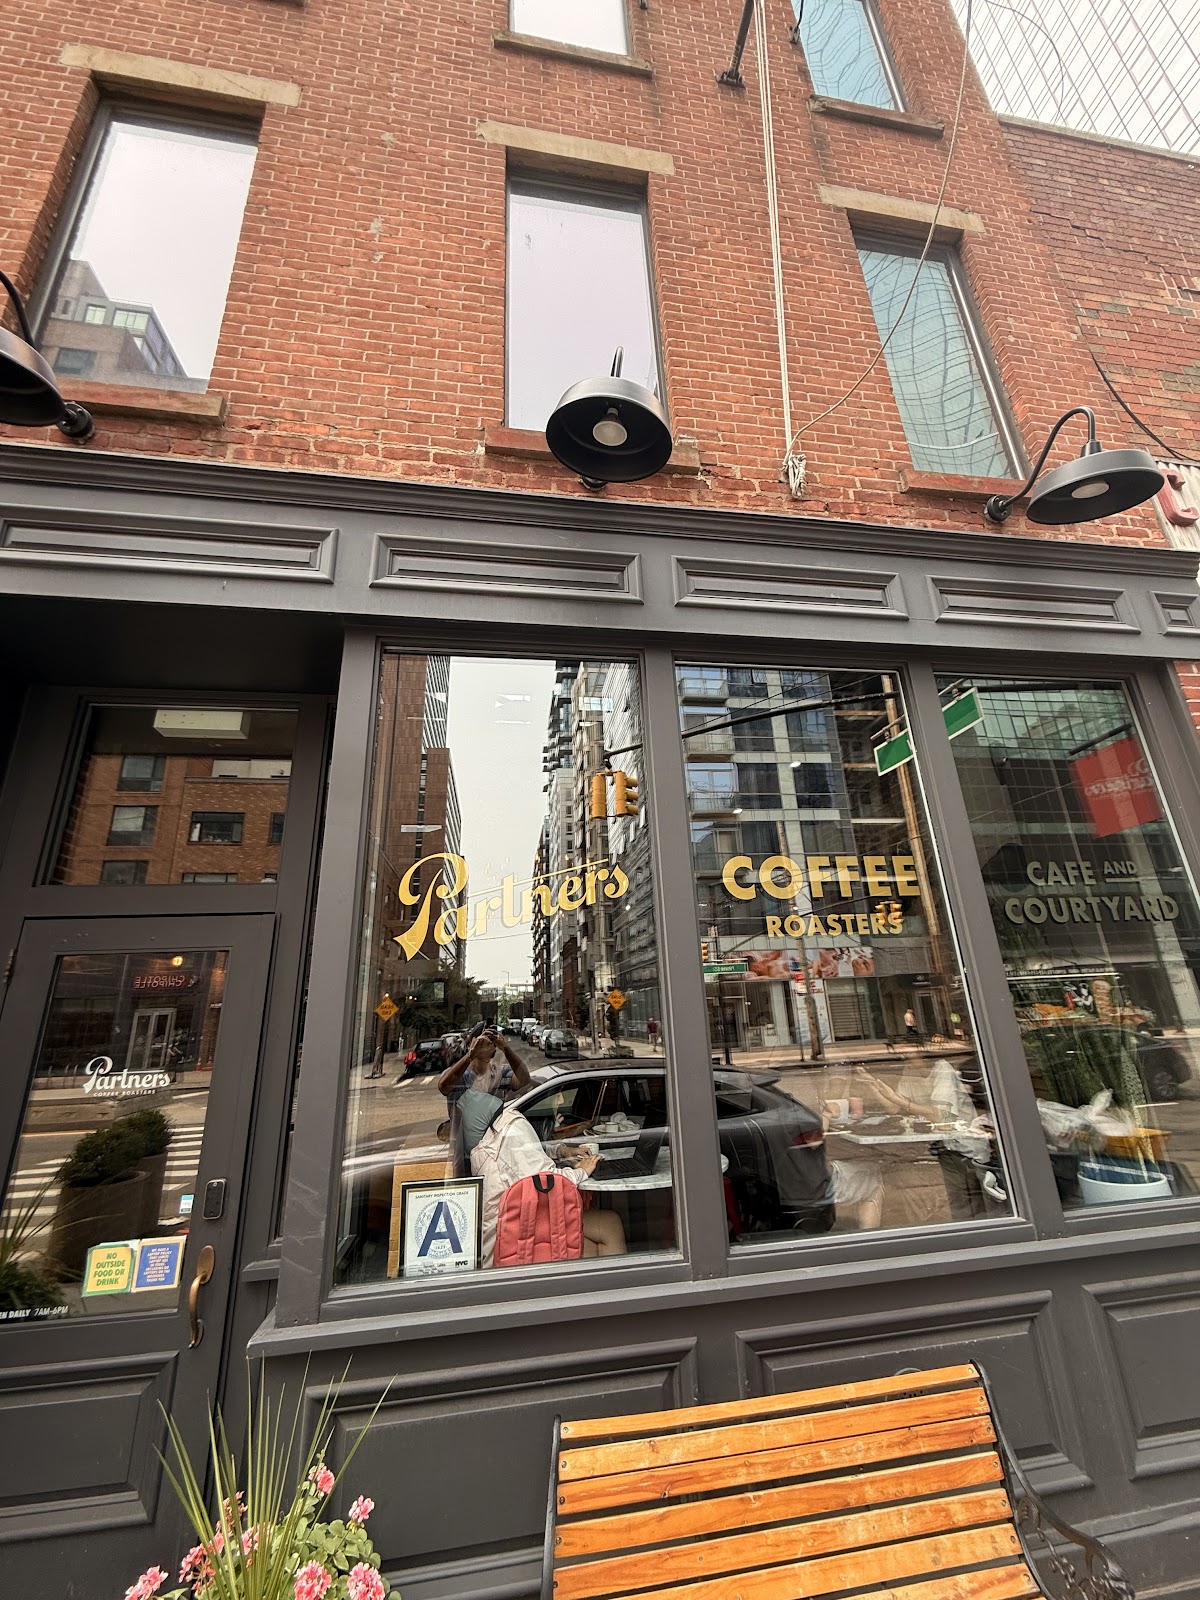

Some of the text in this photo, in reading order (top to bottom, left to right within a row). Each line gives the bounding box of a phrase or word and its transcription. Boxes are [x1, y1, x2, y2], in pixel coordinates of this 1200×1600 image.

[722, 855, 921, 900] COFFEE
[1026, 860, 1138, 886] CAFE AND
[393, 853, 629, 961] Partners
[1004, 895, 1180, 924] COURTYARD
[765, 914, 903, 938] ROASTERS
[82, 1056, 171, 1094] Partners
[417, 1201, 463, 1257] A
[93, 1270, 113, 1278] FOOD
[96, 1260, 126, 1269] OUTSIDE
[96, 1277, 120, 1286] DRINK
[8, 1309, 31, 1319] DAILY
[34, 1305, 69, 1316] 7AM-6PM
